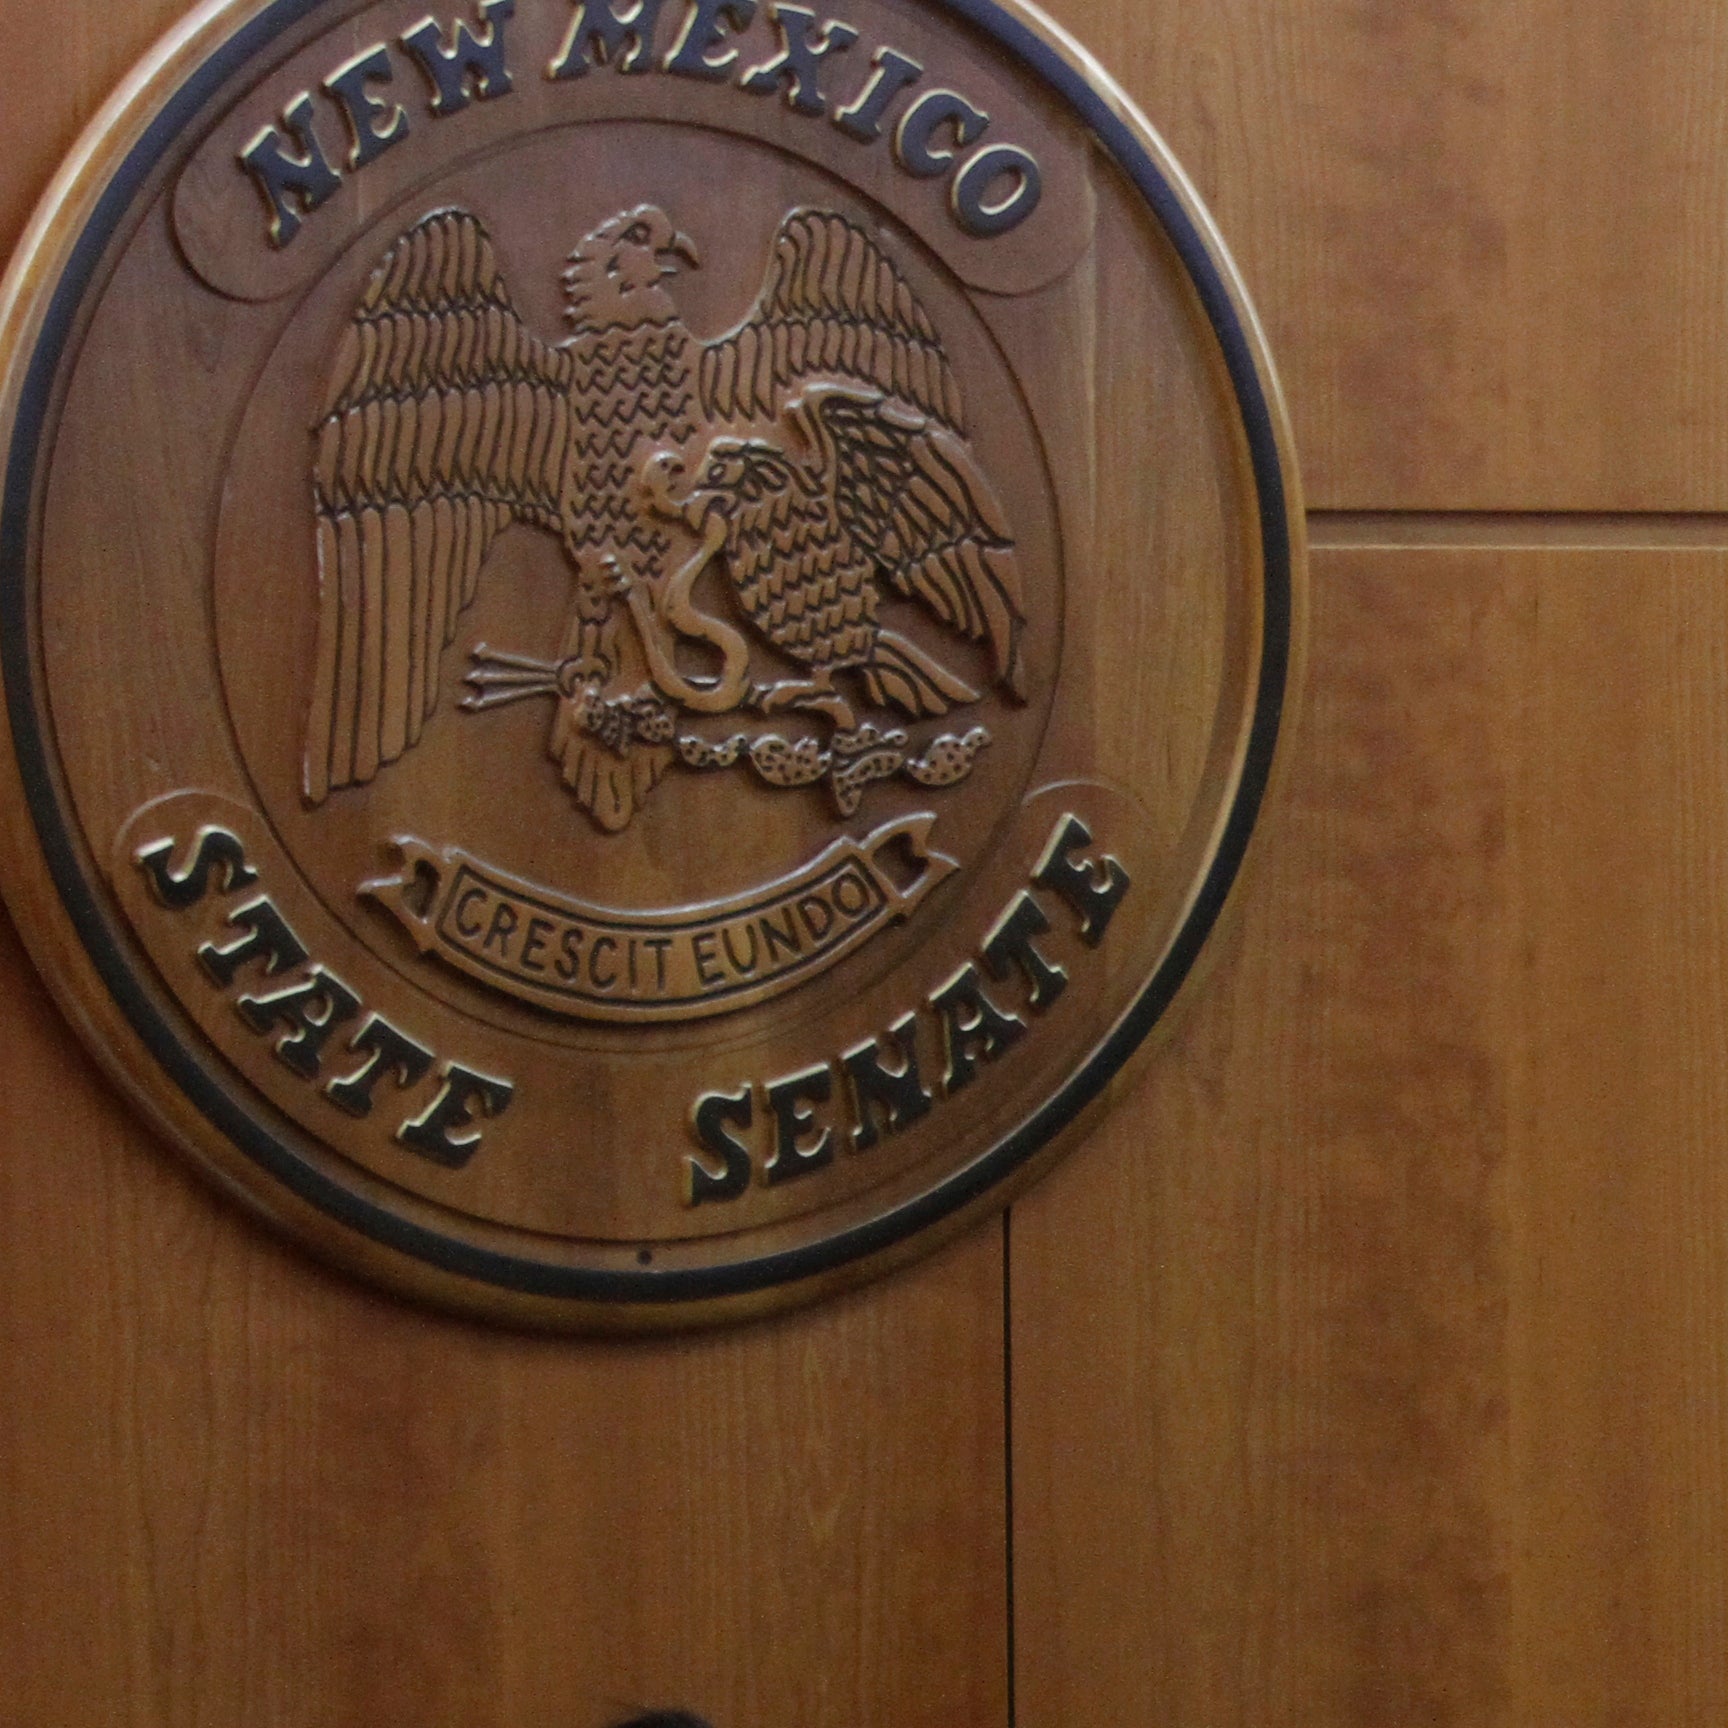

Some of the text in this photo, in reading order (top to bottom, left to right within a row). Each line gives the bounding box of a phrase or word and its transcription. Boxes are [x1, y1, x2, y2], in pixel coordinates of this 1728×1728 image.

[237, 0, 1043, 249] NEW MEXICO
[136, 812, 1131, 1206] STATE SENATE
[455, 871, 870, 992] CRESCIT EUNDO
